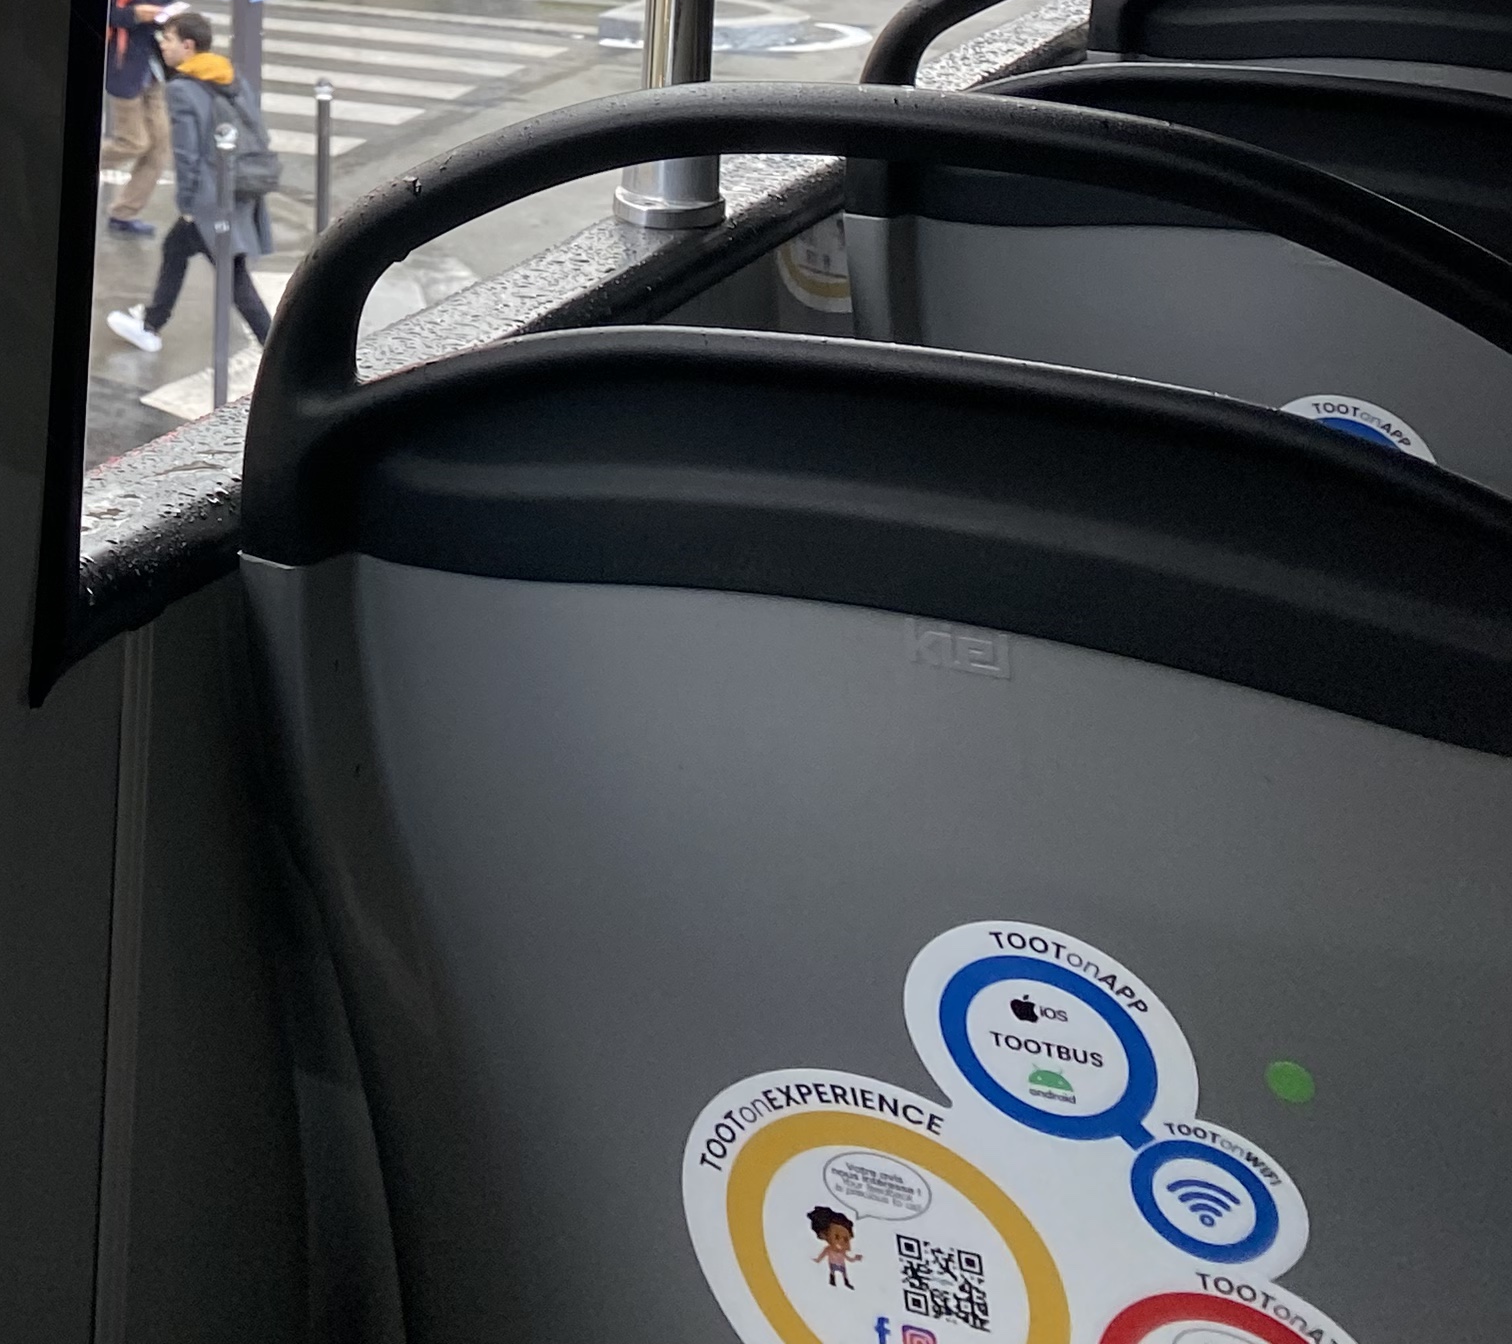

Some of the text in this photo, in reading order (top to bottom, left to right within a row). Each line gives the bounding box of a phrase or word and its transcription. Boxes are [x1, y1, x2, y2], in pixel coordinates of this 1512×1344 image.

[1312, 402, 1412, 447] TOOTonAPP
[989, 931, 1149, 1014] TOOTonAPP
[1040, 1005, 1069, 1023] iOS
[989, 1031, 1104, 1069] TOOTBUS
[1029, 1087, 1077, 1105] android
[700, 1083, 945, 1172] TOOTonEXPERIENCE
[1196, 1272, 1339, 1344] TOOTonA
